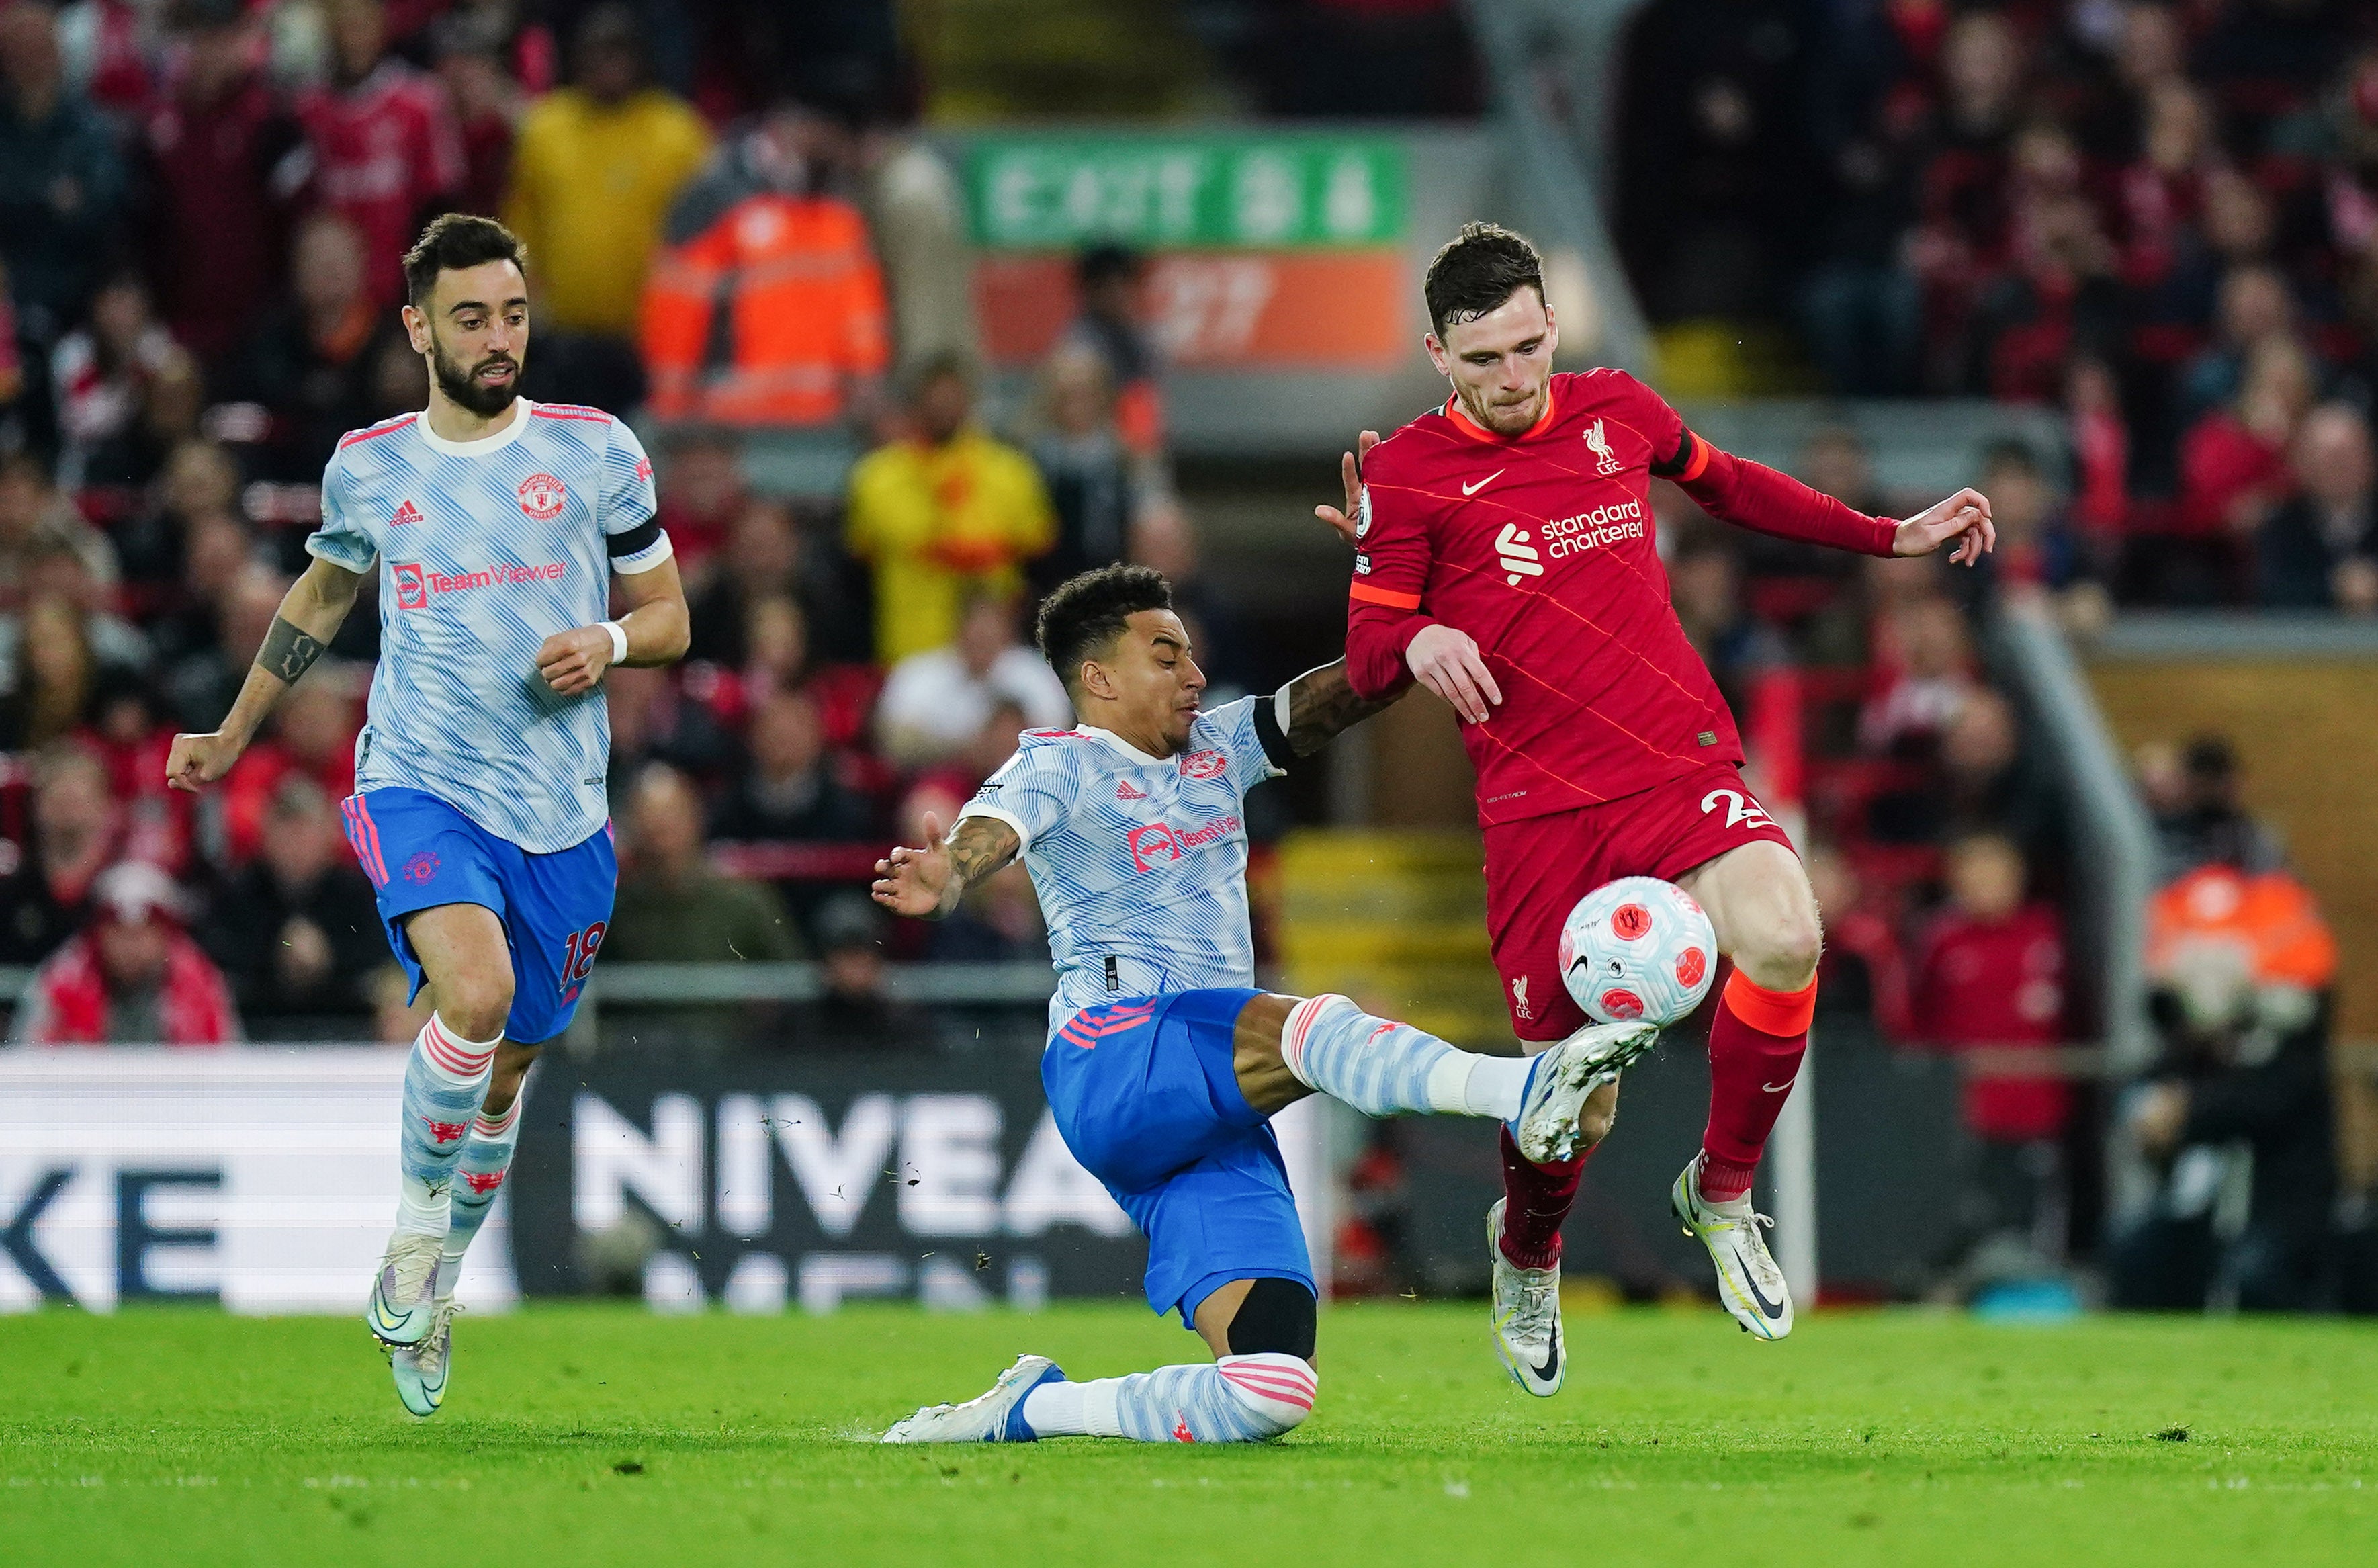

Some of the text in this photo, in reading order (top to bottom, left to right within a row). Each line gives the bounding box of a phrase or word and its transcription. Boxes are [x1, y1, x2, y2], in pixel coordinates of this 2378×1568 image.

[390, 515, 424, 527] adidas
[1541, 498, 1642, 540] standard
[1548, 519, 1644, 558] chartered
[427, 562, 566, 593] TeamViewer
[559, 920, 607, 992] 18
